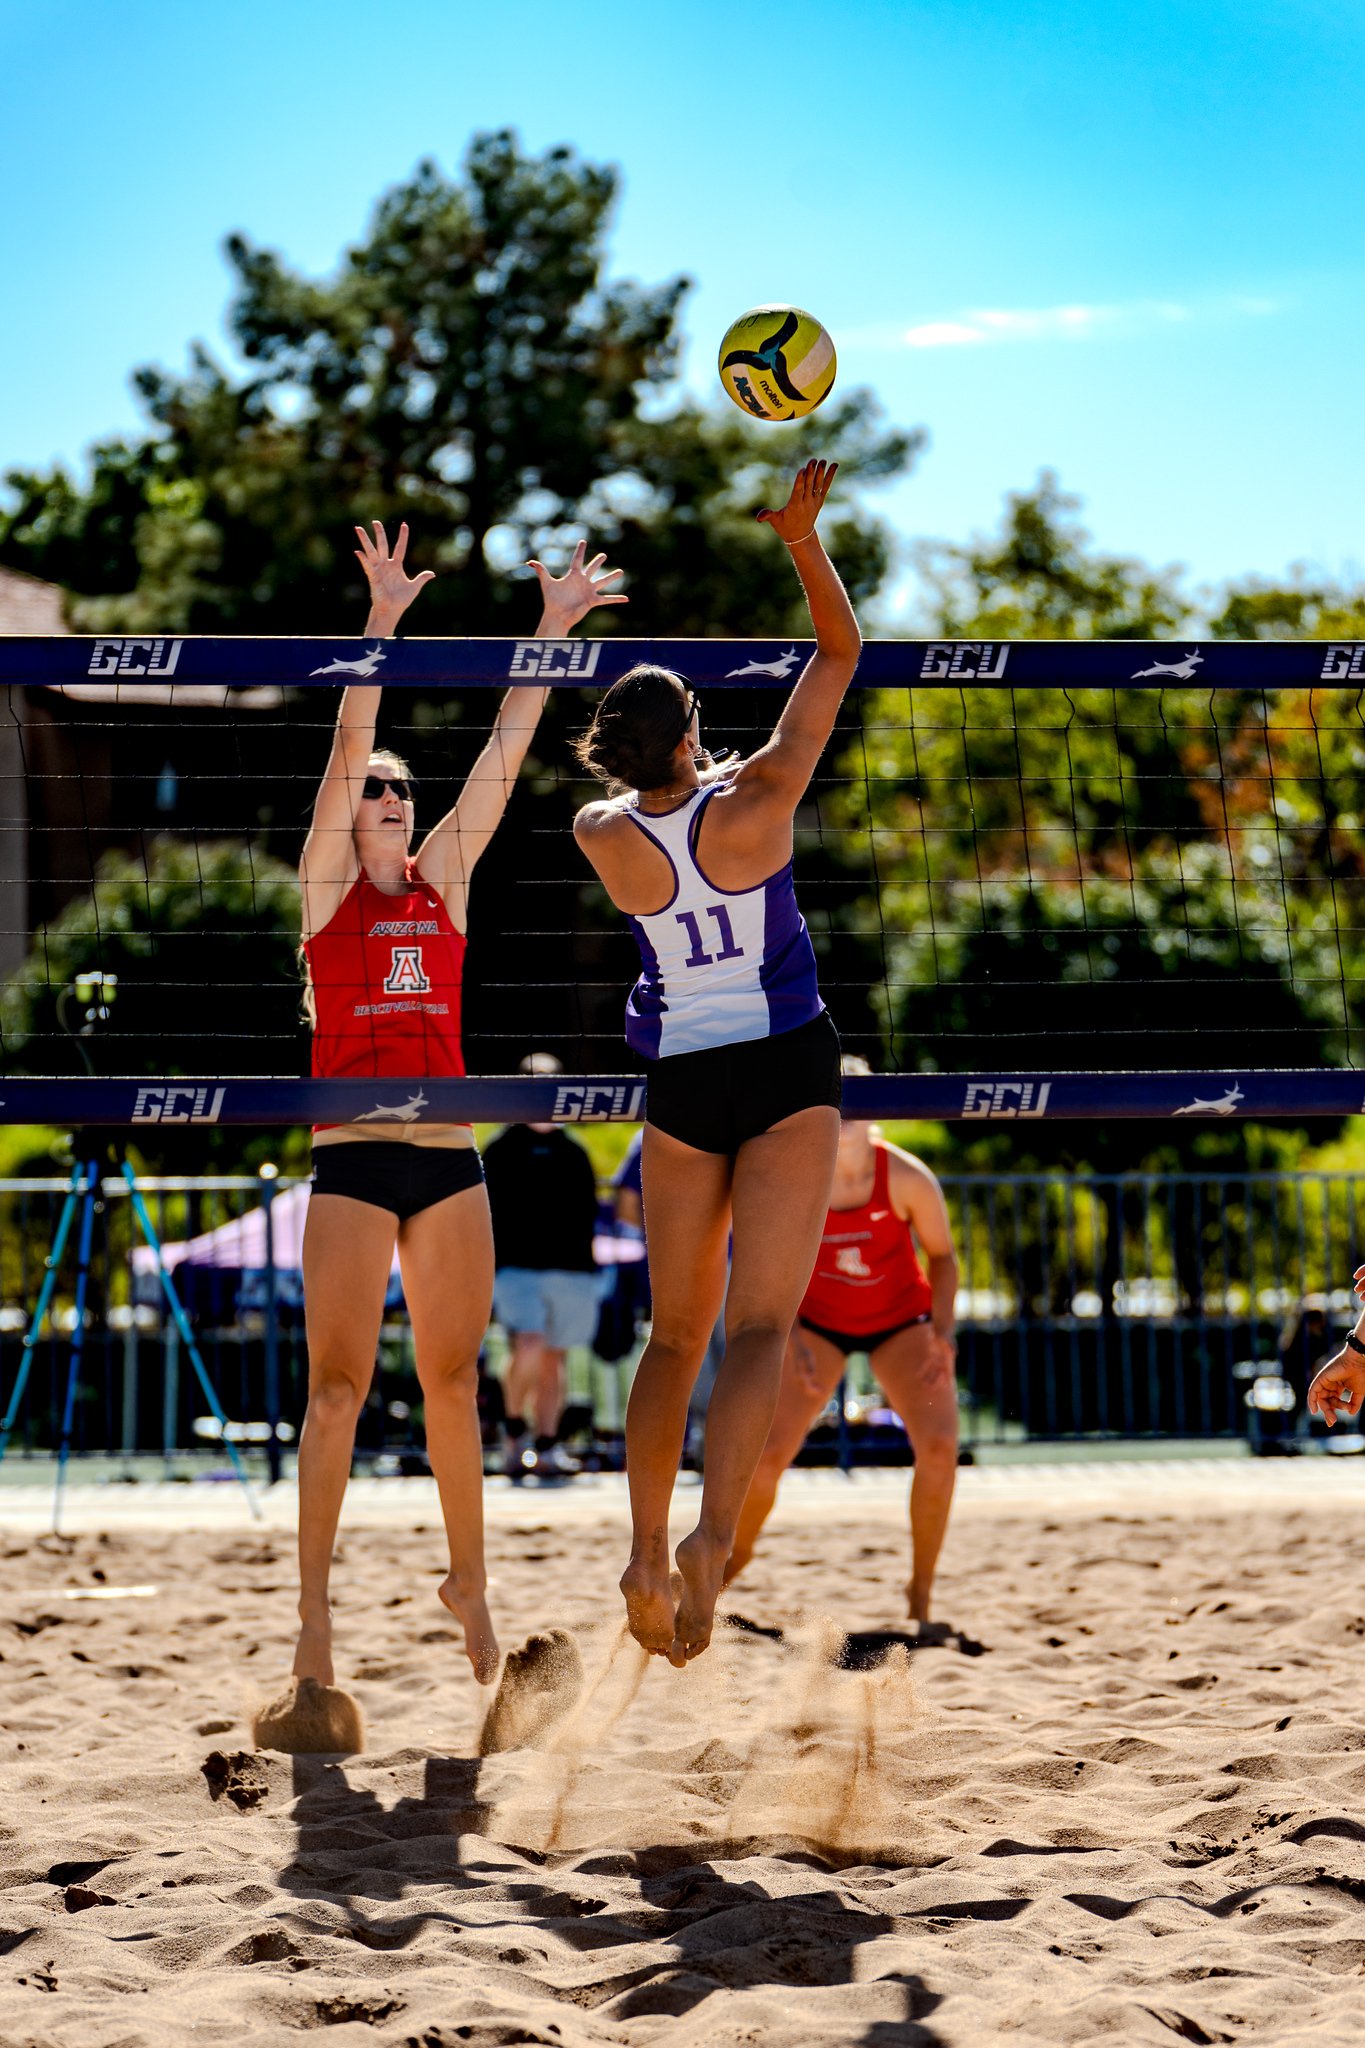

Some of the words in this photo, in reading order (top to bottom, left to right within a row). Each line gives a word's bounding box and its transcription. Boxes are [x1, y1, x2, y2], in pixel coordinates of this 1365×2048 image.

[760, 380, 783, 409] molten
[88, 640, 184, 675] GCU
[509, 642, 603, 677] GCU
[920, 644, 1010, 679] GCU
[368, 920, 439, 937] ARIZONA
[675, 904, 744, 967] 11
[384, 946, 431, 994] A
[354, 1003, 392, 1016] BEACH
[131, 1088, 227, 1122] GCU
[552, 1086, 645, 1121] GCU
[962, 1083, 1052, 1118] GCU
